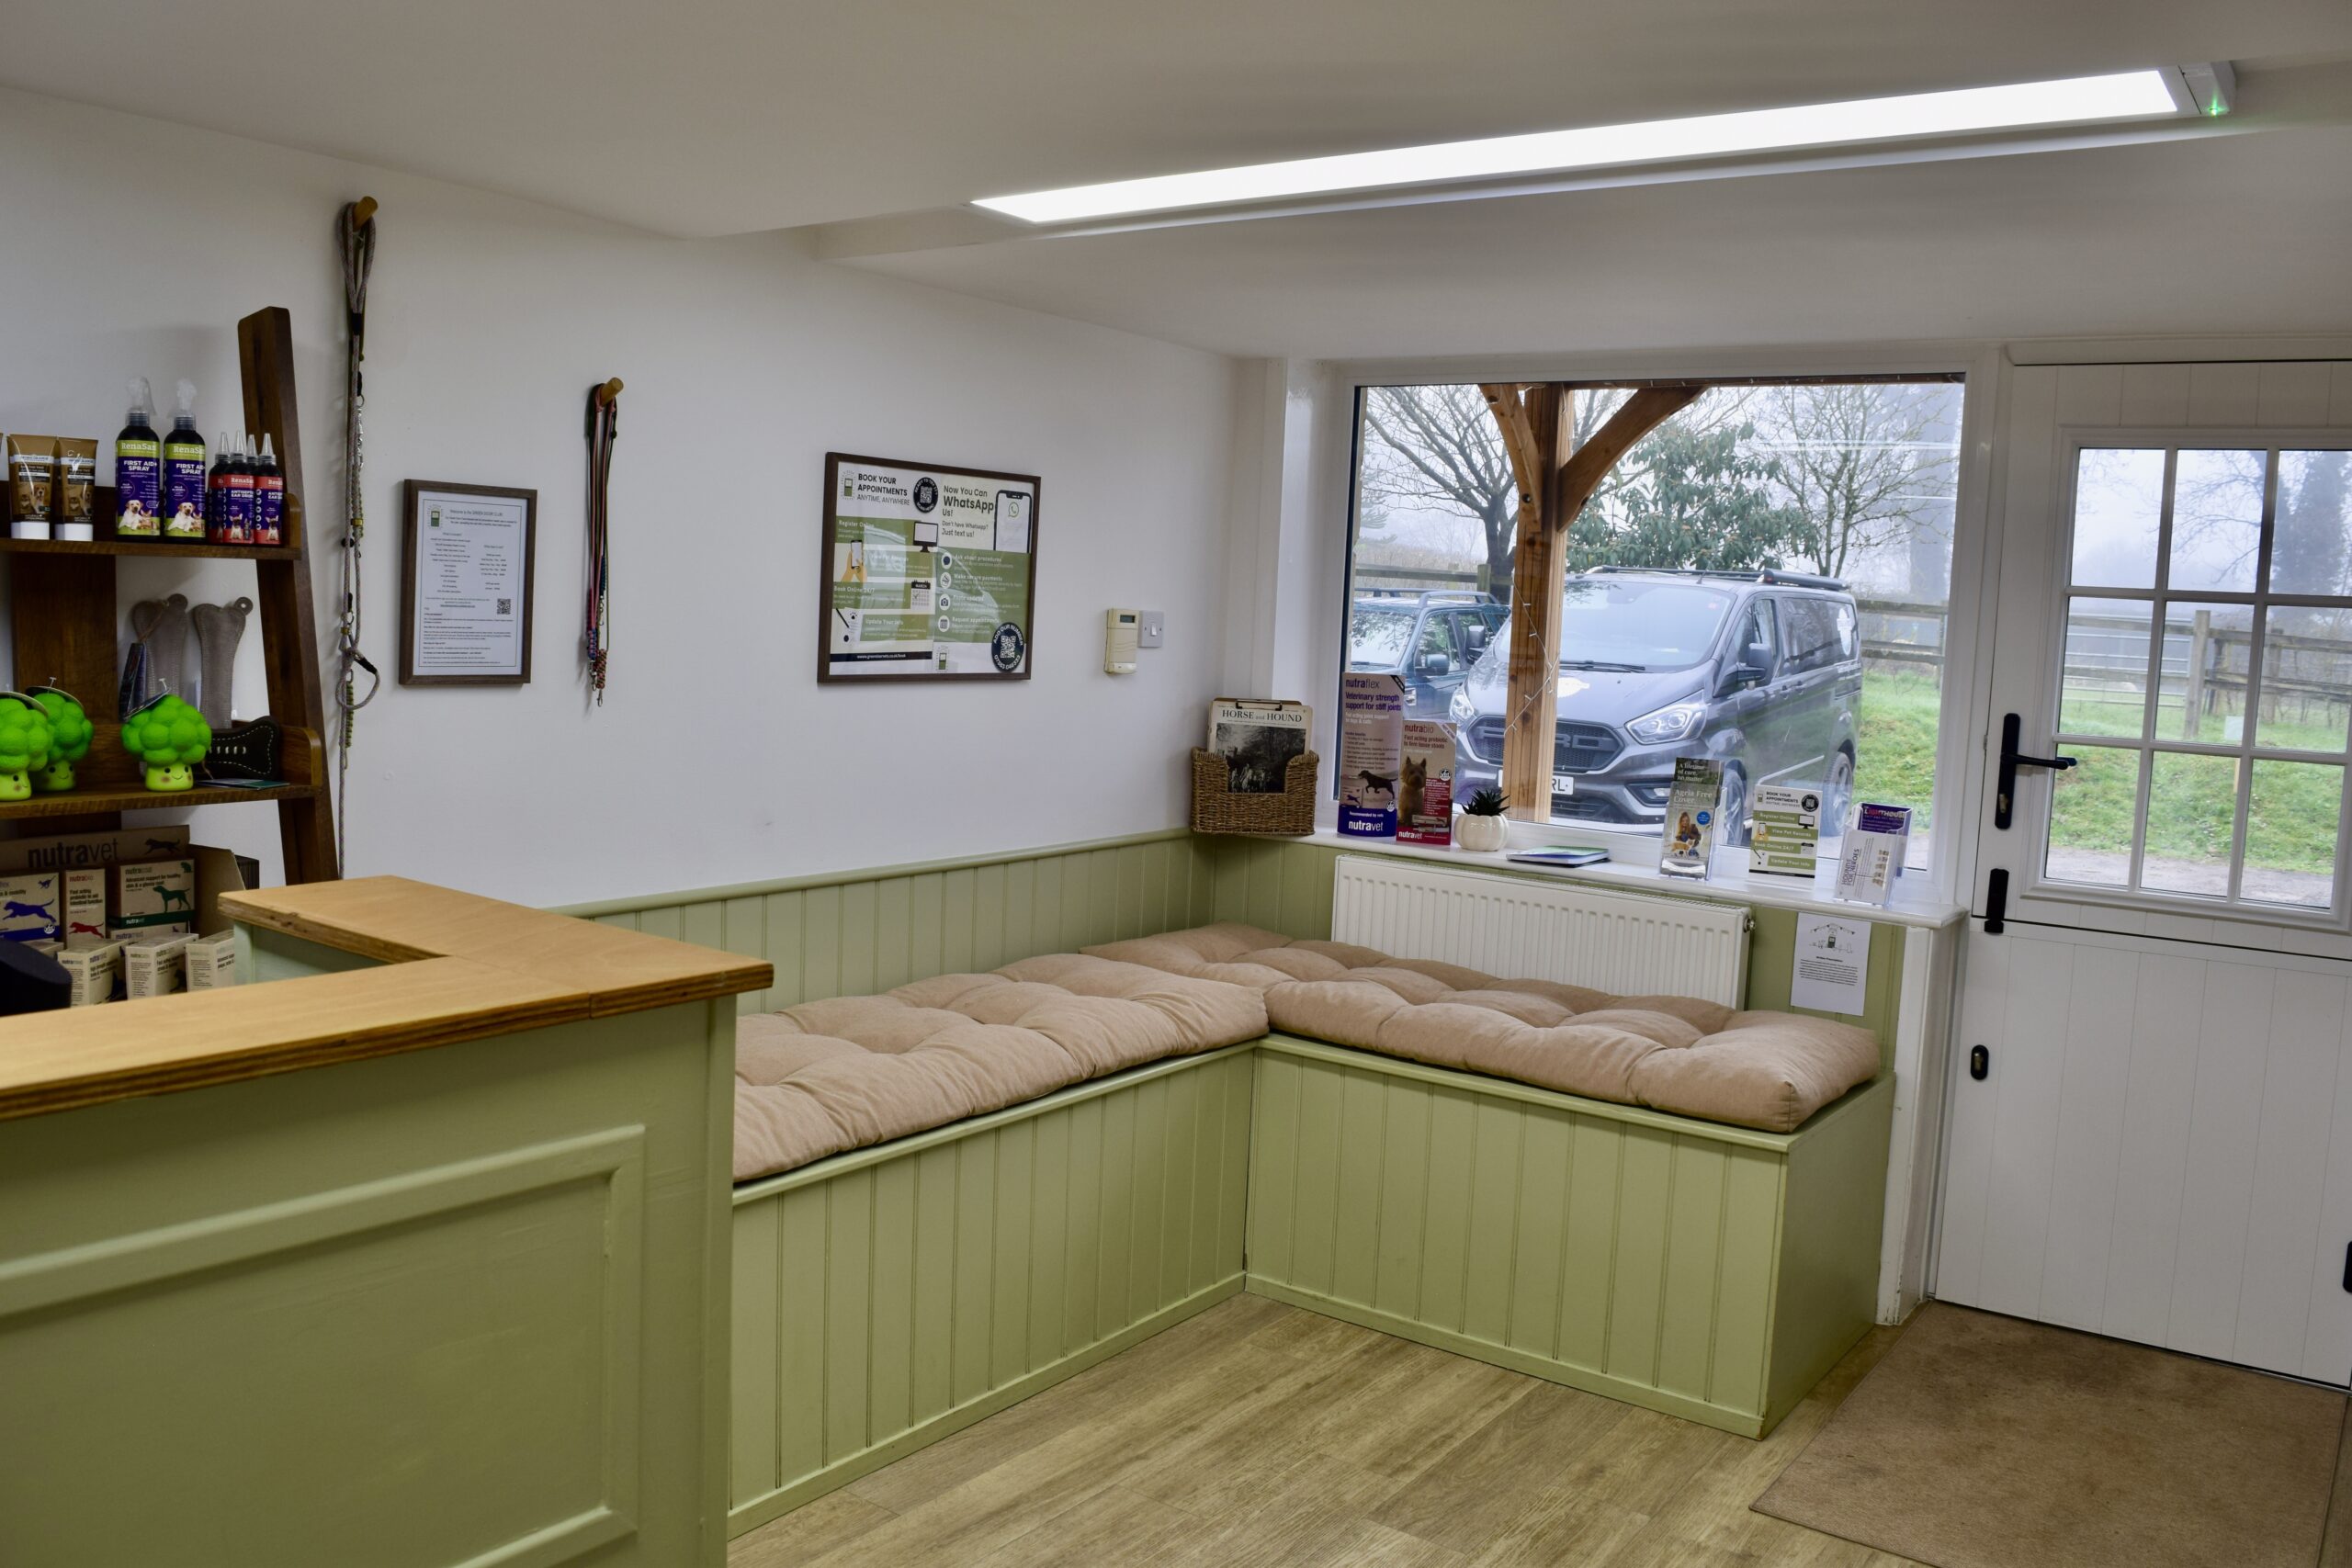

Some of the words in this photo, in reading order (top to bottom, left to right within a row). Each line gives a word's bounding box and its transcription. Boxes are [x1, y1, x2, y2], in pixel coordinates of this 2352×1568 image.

[121, 443, 156, 451] RenaSan
[174, 446, 205, 455] RenaSa
[858, 473, 877, 482] BOOK
[878, 477, 897, 485] YOUR
[857, 484, 908, 496] APPOINTMENTS
[944, 485, 958, 494] Now
[960, 487, 973, 496] You
[974, 489, 988, 497] Can
[856, 494, 881, 502] ANYTIME,
[882, 497, 910, 505] ANYWHERE
[944, 495, 994, 514] WhatsApp
[943, 509, 953, 517] Us!
[942, 528, 954, 536] Just
[1345, 678, 1380, 689] nutraflex
[1345, 692, 1374, 702] Veterinary
[1375, 694, 1399, 703] strength
[1345, 702, 1364, 711] support
[1387, 704, 1402, 712] joints
[1222, 710, 1255, 719] HORSE
[1267, 713, 1303, 723] HOUND
[1405, 724, 1433, 734] nutrabio
[1674, 789, 1695, 797] Agria
[1348, 819, 1383, 831] nutravet
[1398, 830, 1422, 839] nutravet
[28, 838, 119, 868] nutravet
